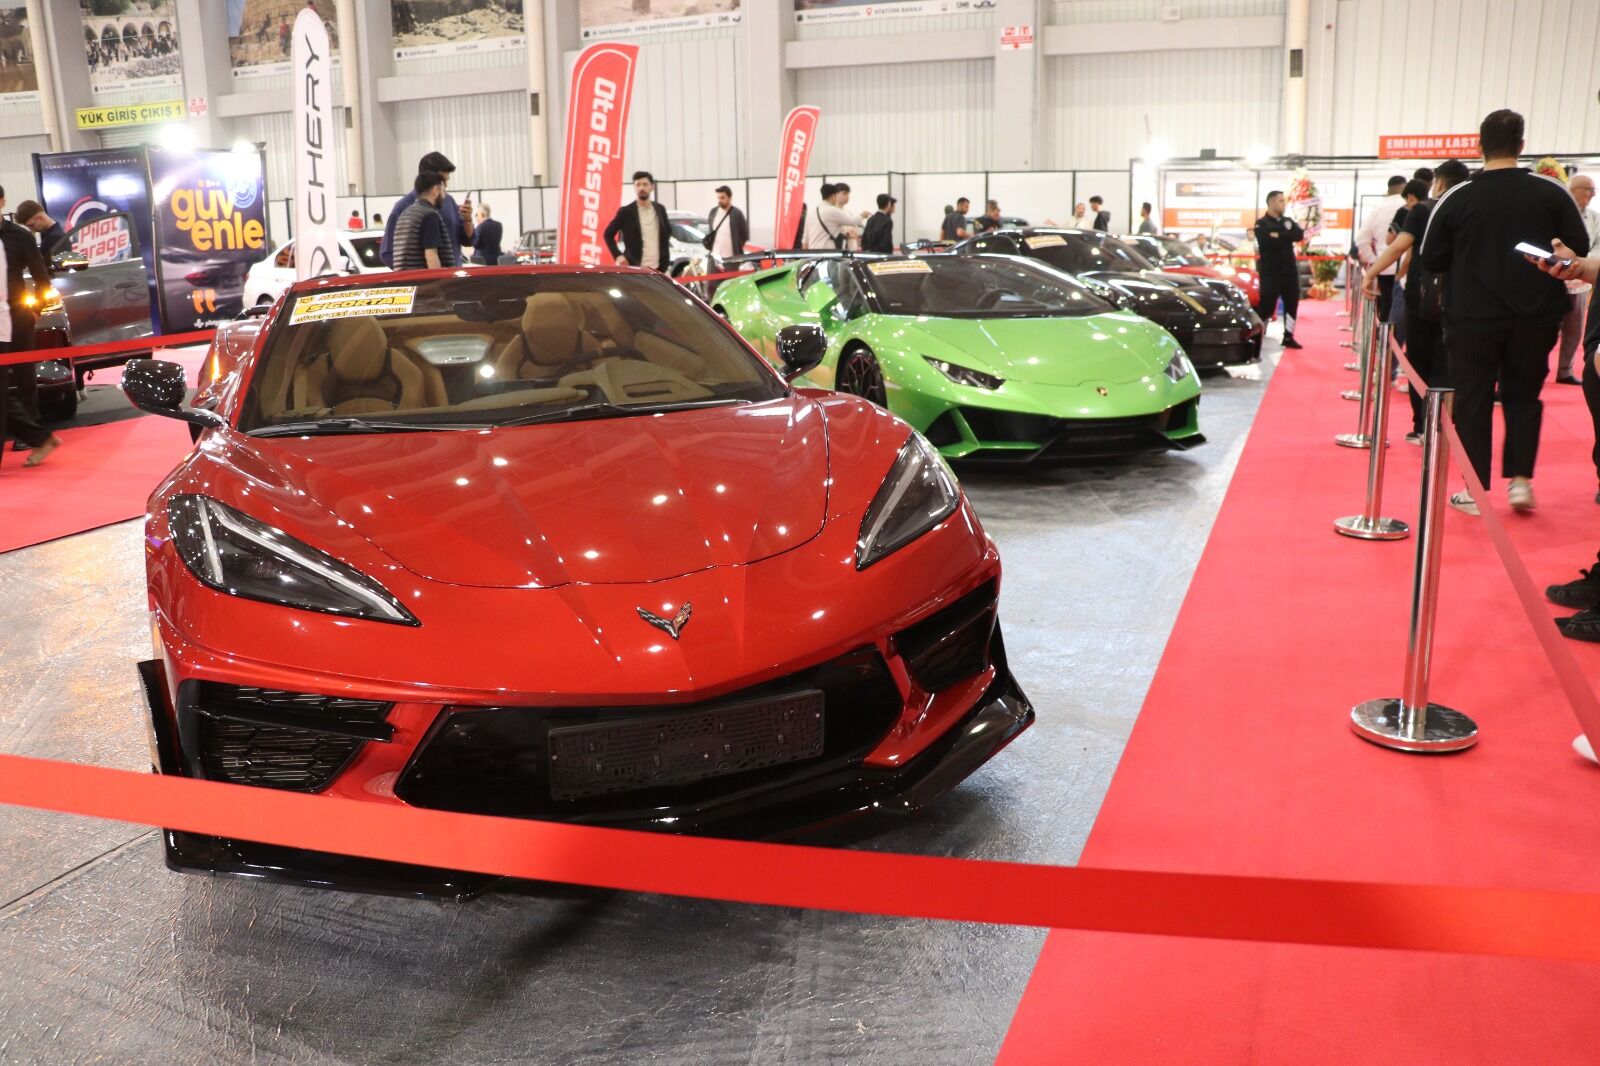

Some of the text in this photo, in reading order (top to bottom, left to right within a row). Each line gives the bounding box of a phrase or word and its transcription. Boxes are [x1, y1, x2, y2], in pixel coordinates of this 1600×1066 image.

[80, 111, 104, 125] YÜK
[107, 108, 137, 123] GİRİŞ
[140, 105, 172, 120] ÇIKIŞ
[175, 104, 182, 117] 1
[590, 76, 617, 133] Oto
[305, 33, 327, 226] CHERY
[789, 128, 807, 167] Oto
[79, 216, 119, 243] Pilot
[191, 211, 264, 251] enle
